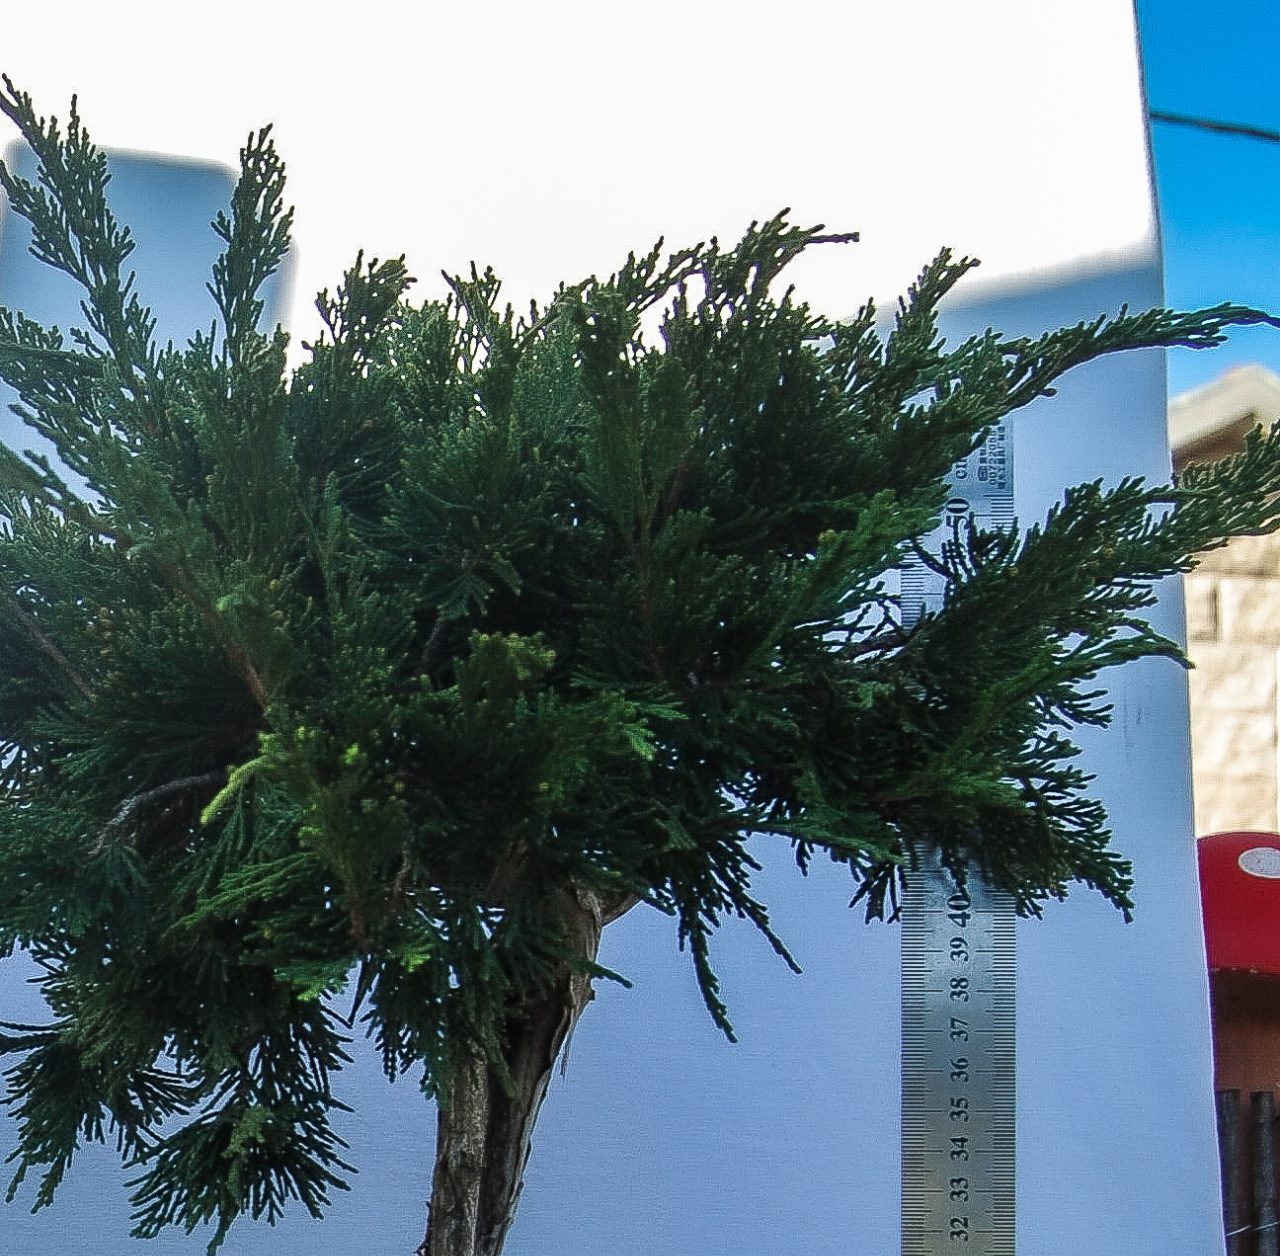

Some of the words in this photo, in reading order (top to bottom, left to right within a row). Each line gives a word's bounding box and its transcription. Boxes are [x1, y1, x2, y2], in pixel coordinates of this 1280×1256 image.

[946, 498, 970, 529] 50
[947, 894, 971, 928] 40
[949, 937, 969, 962] 39
[949, 977, 969, 1002] 38
[949, 1017, 969, 1043] 37
[949, 1057, 969, 1083] 36
[949, 1097, 969, 1122] 35
[949, 1136, 969, 1162] 34
[949, 1177, 969, 1202] 33
[949, 1216, 969, 1242] 32
